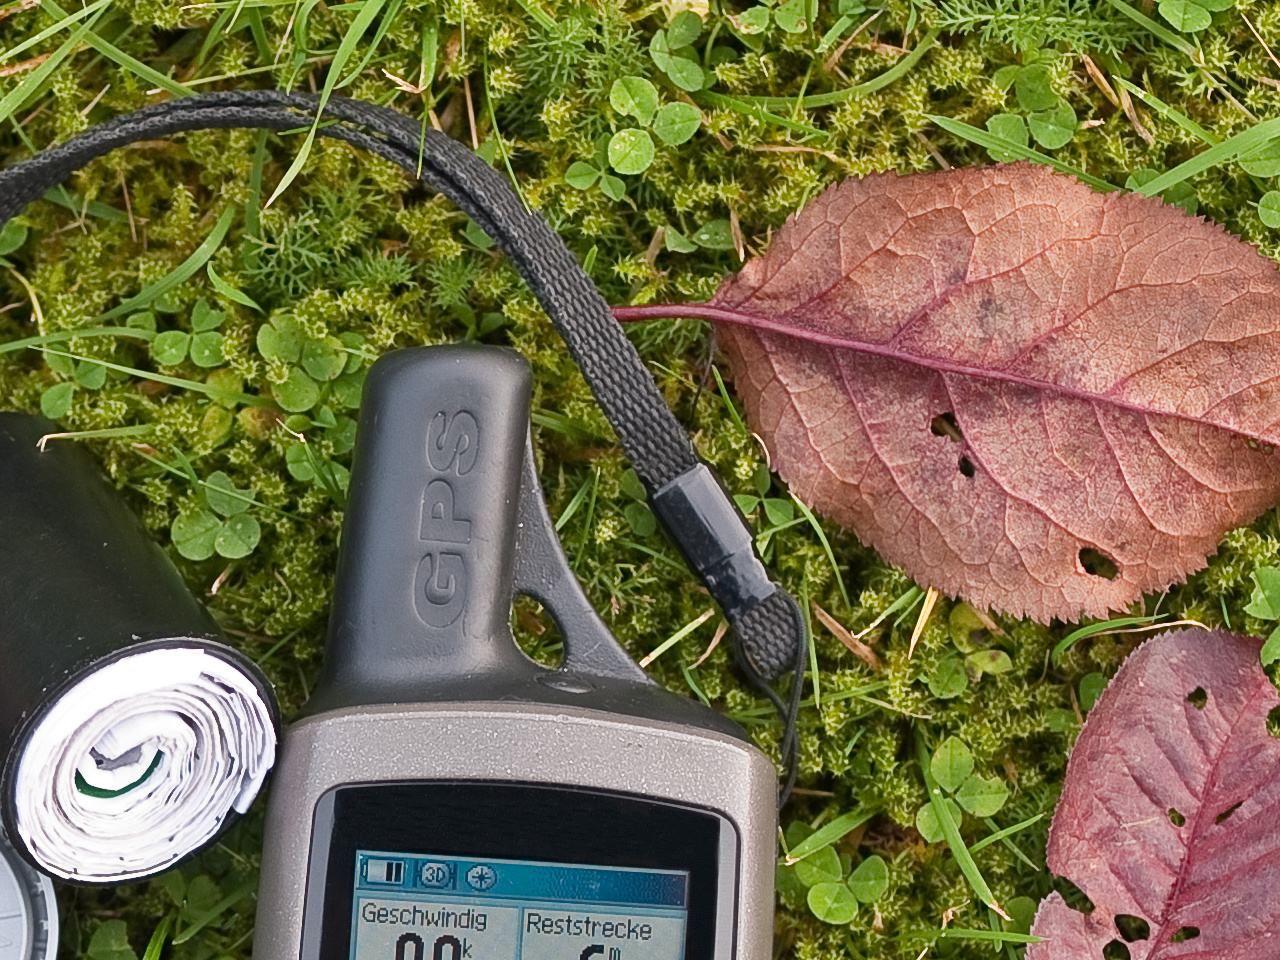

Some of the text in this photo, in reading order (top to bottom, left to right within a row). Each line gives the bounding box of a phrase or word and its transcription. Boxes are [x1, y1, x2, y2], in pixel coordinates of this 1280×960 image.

[412, 409, 480, 628] GPS
[424, 865, 446, 884] 3D
[361, 902, 488, 931] Geschwindig
[527, 912, 652, 941] Reststrecke
